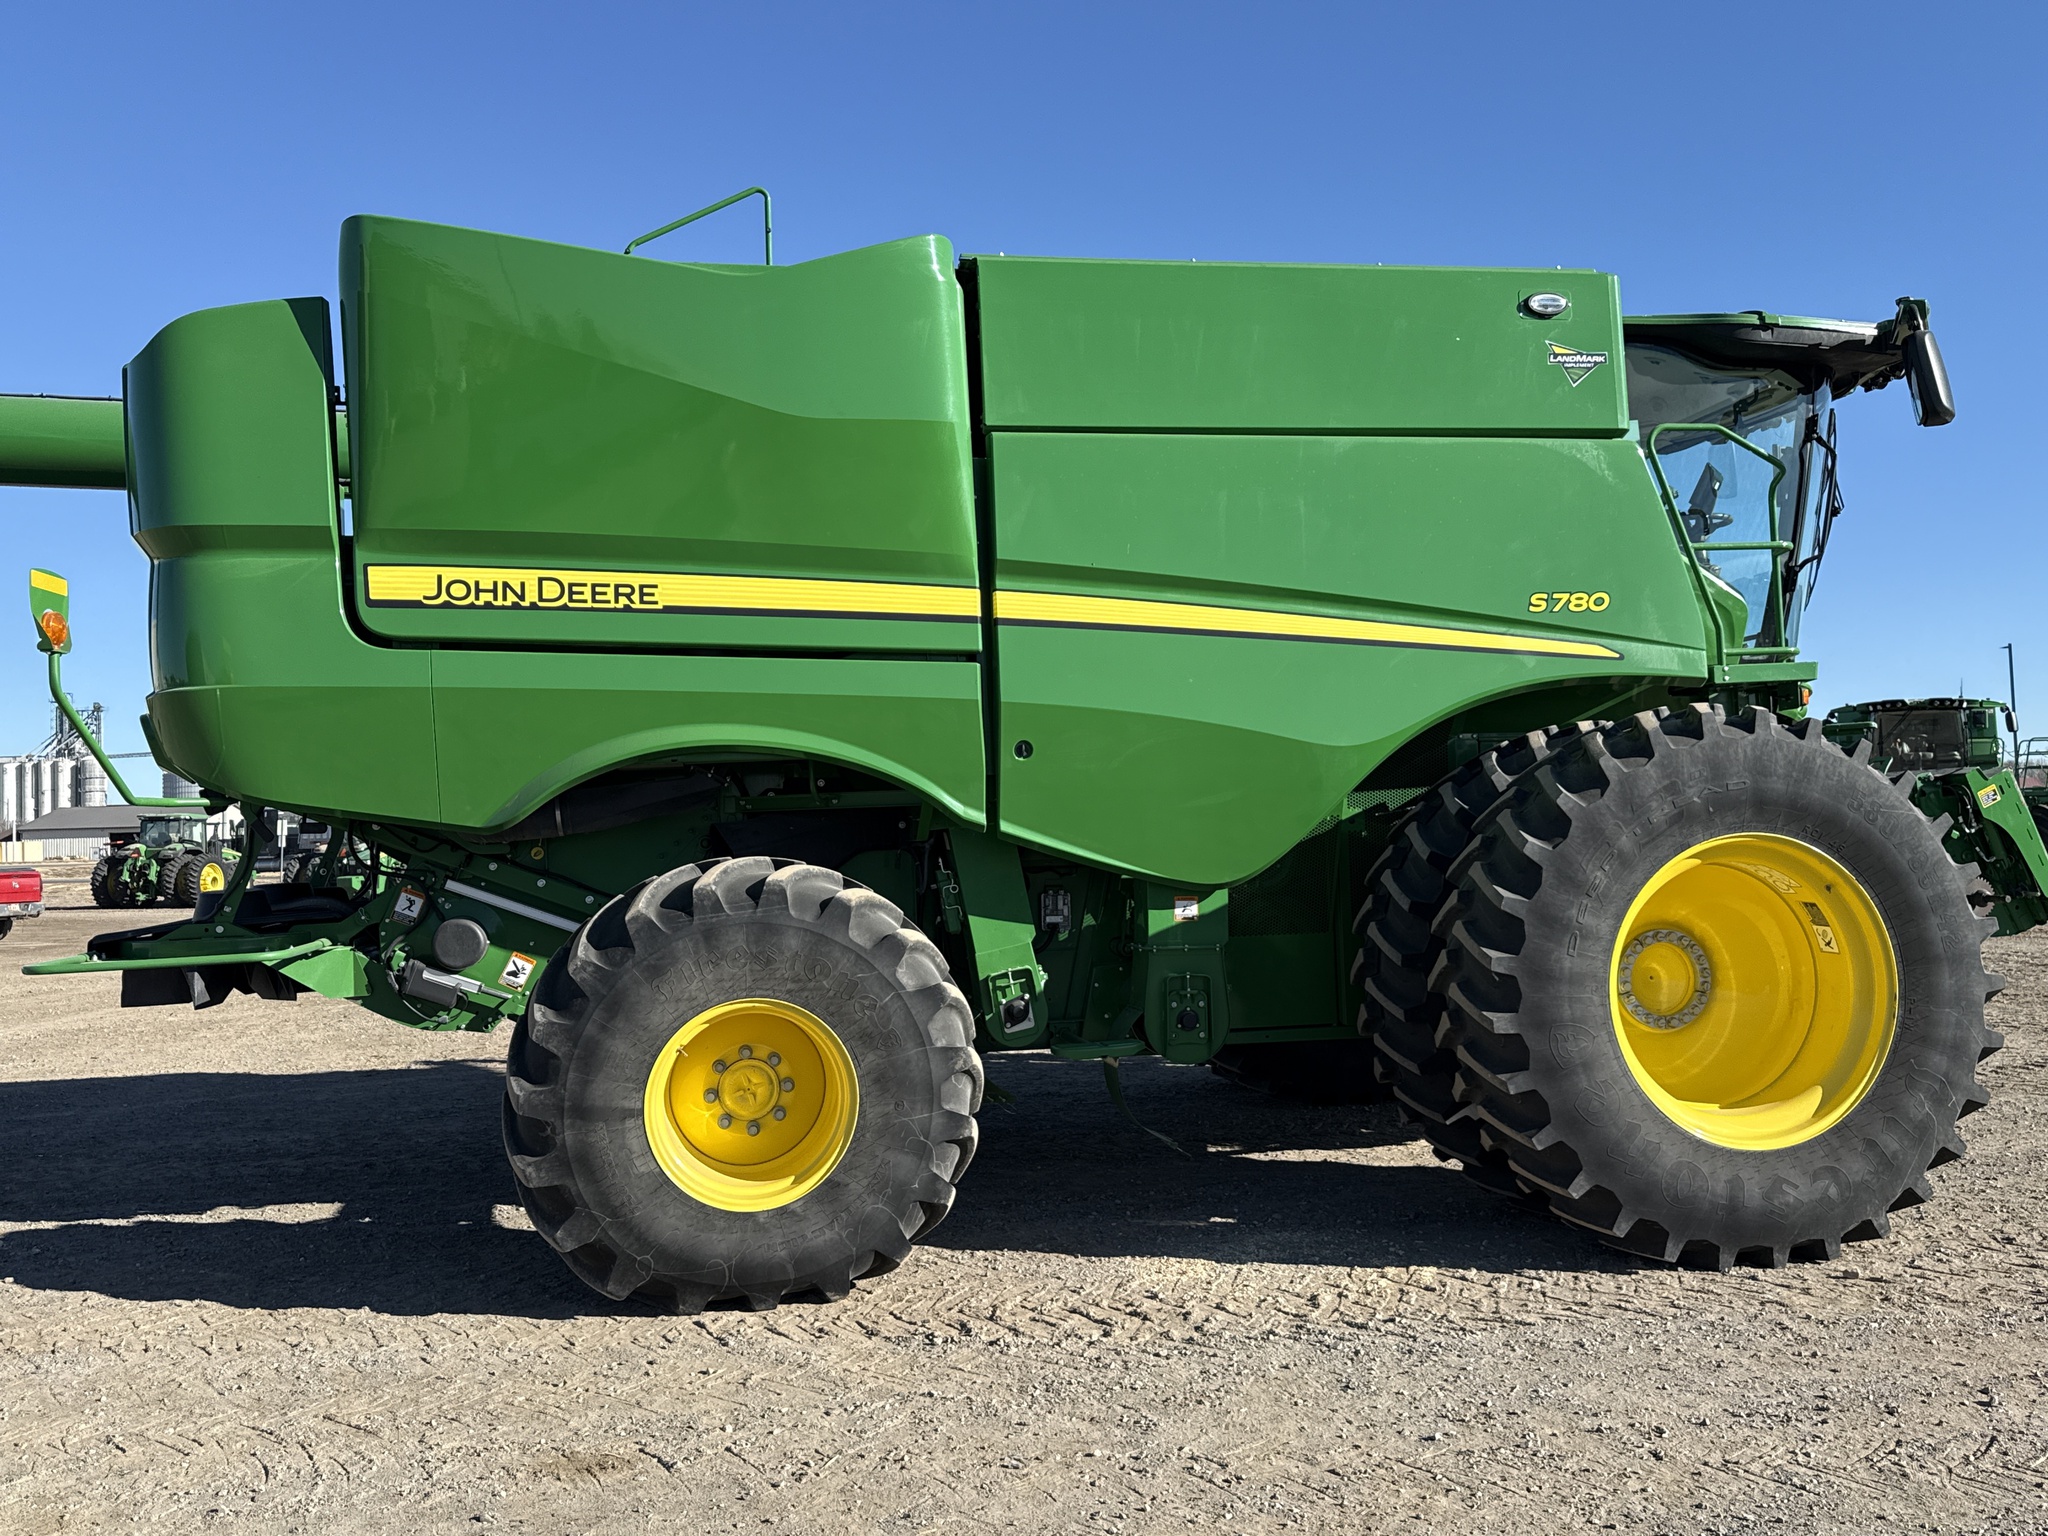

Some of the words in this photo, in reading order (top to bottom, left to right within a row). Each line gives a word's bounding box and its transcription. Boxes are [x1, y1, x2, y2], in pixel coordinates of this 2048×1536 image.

[1550, 354, 1605, 363] LANDMARK
[422, 574, 526, 603] JOHN
[538, 576, 660, 605] DEERE
[1528, 591, 1611, 612] S780
[1846, 788, 1963, 954] 580/85R42
[651, 944, 879, 1018] Firestone
[1573, 1058, 1940, 1224] Firestone
